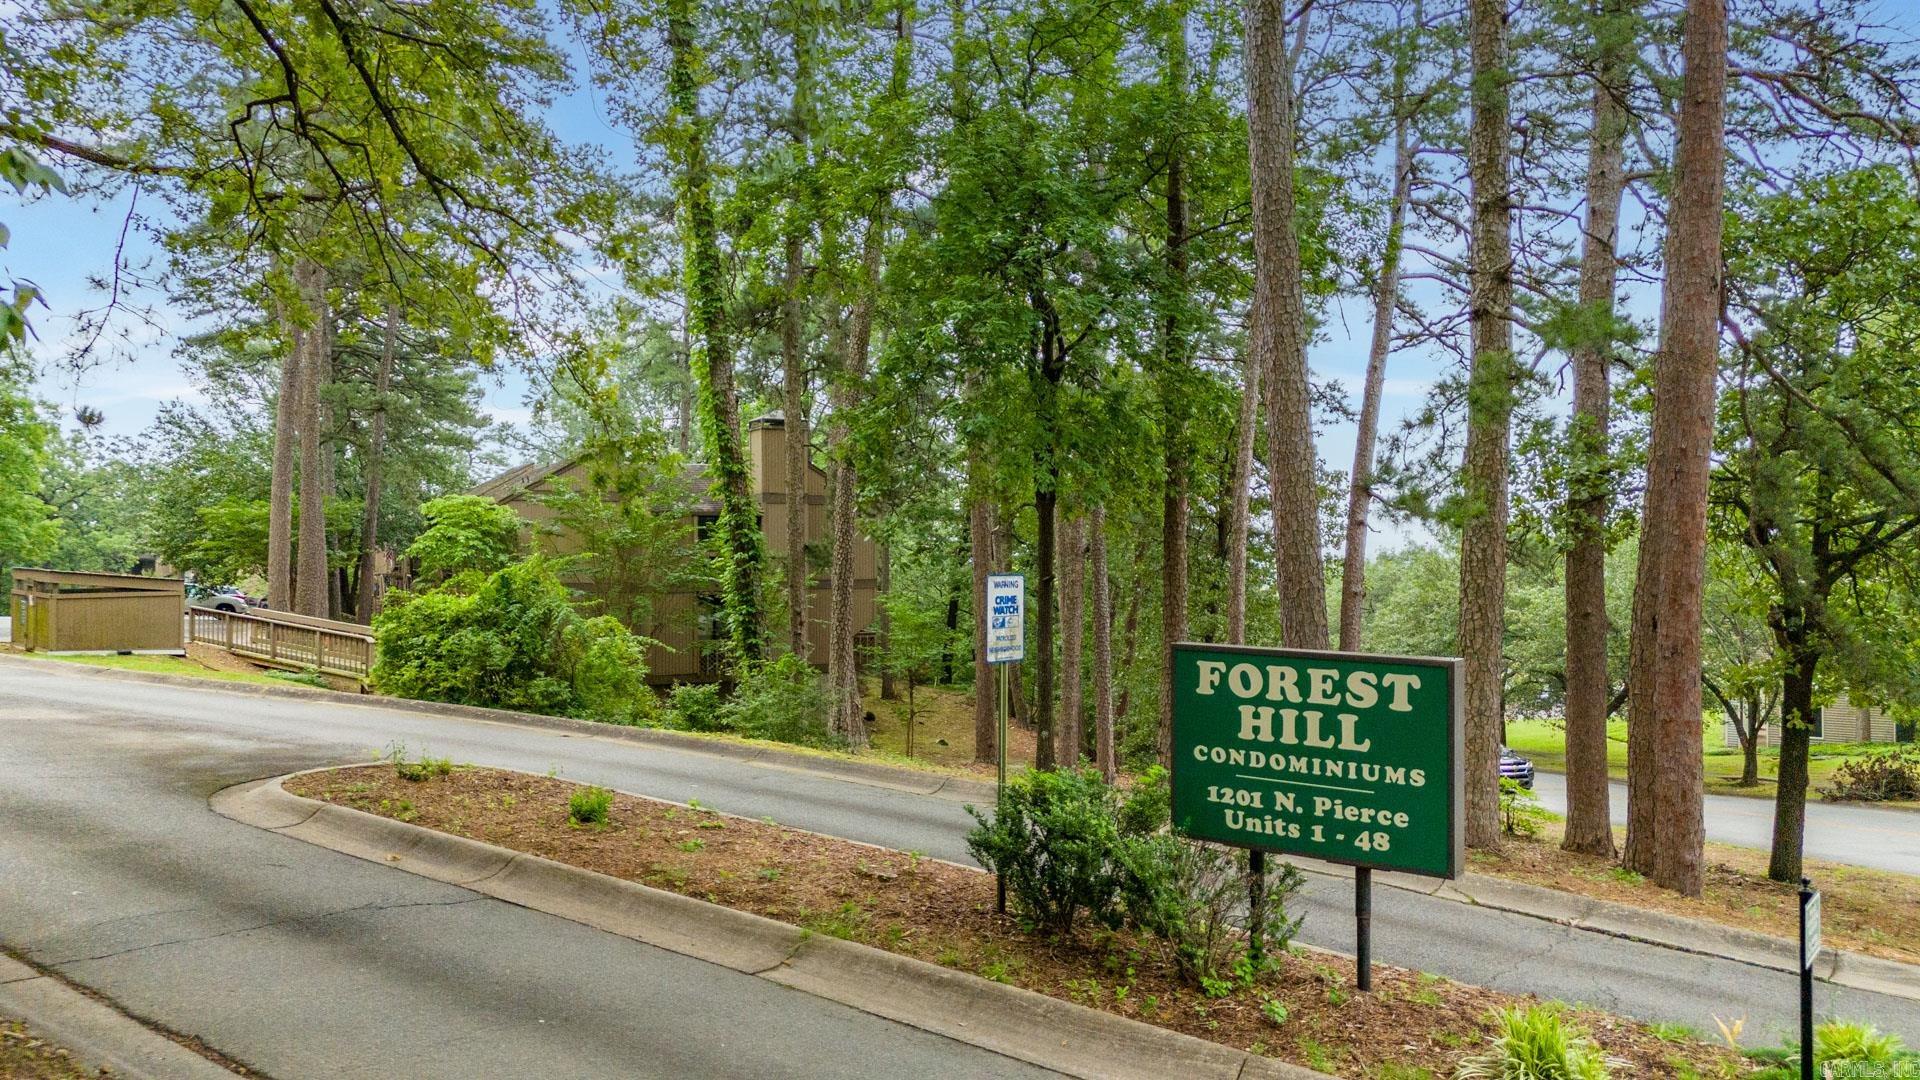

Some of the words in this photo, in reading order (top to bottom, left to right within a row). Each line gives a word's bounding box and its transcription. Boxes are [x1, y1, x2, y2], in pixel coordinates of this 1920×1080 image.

[993, 605, 1019, 615] WATCH
[995, 595, 1017, 605] CRIME
[1195, 660, 1422, 712] FOREST
[1237, 704, 1371, 753] HILL
[1193, 745, 1426, 787] CONDOMINIUMS
[1206, 785, 1264, 809] 1201
[1273, 790, 1303, 814] N.
[1313, 796, 1410, 828] Pierce
[1224, 808, 1301, 839] Units
[1310, 824, 1326, 843] 1
[1354, 830, 1391, 852] 48
